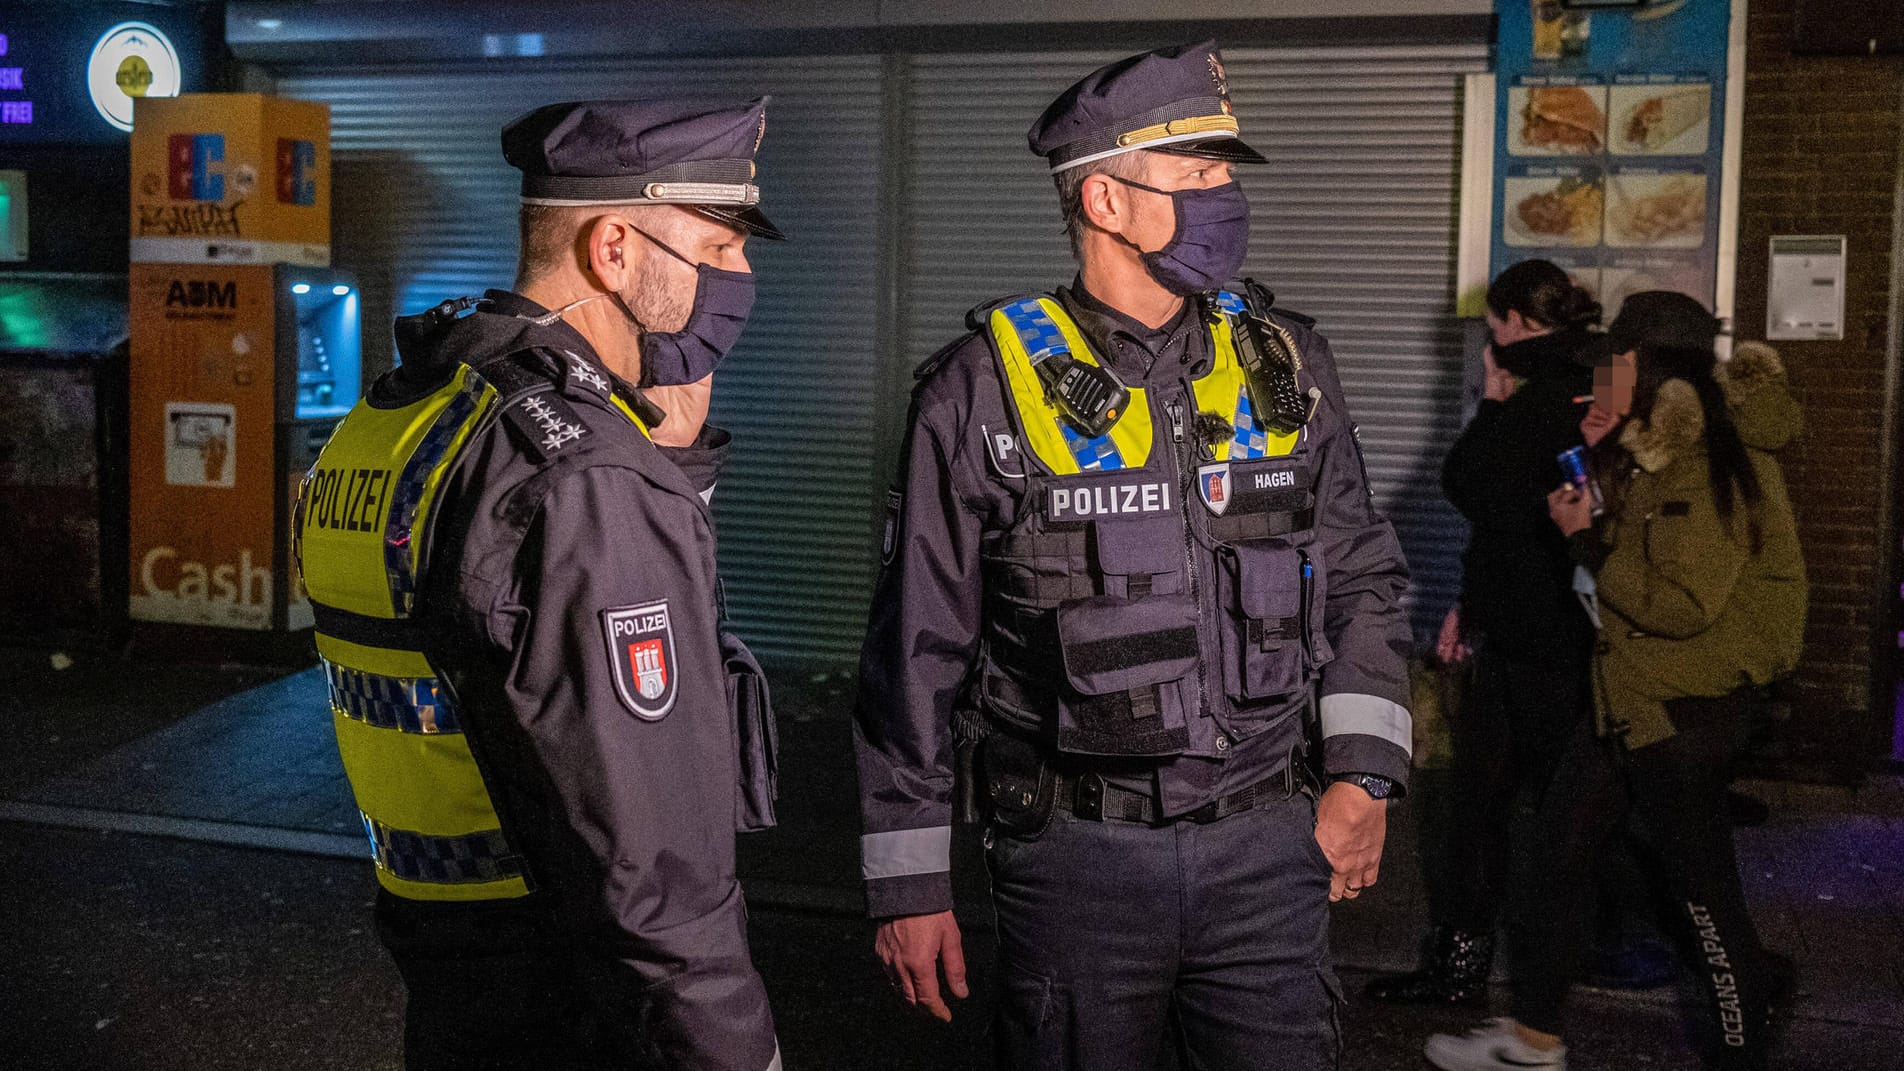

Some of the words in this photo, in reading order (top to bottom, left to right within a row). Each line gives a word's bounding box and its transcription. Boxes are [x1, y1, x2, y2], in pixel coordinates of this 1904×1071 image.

[2, 101, 33, 124] FREI
[307, 468, 391, 533] POLIZEI
[1053, 483, 1170, 517] POLIZEI
[1255, 471, 1295, 489] HAGEN
[142, 546, 273, 606] Cash
[614, 614, 667, 638] POLIZEI
[1688, 901, 1731, 968] APART
[1712, 973, 1745, 1047] OCEANS
